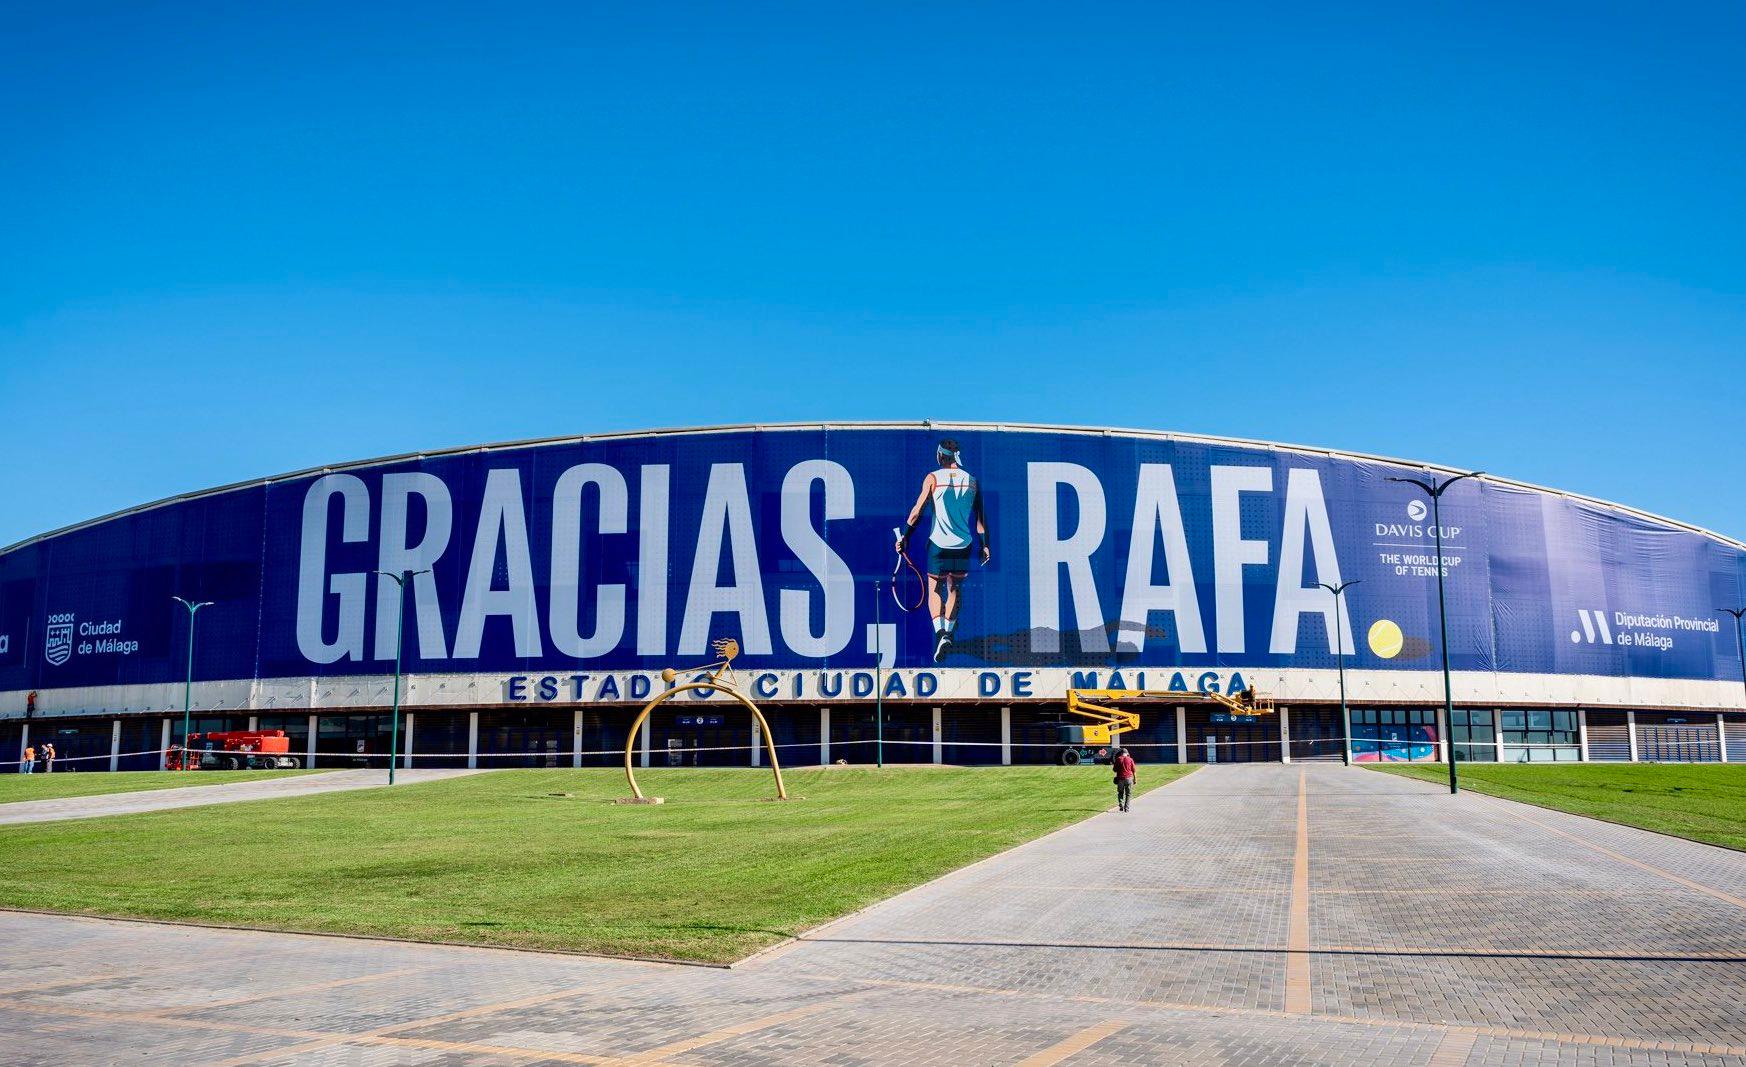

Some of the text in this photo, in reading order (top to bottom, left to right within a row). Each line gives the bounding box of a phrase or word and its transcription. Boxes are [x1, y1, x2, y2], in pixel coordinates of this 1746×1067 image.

[1375, 523, 1460, 539] DAVIS CUP
[297, 459, 1356, 668] GRACIAS, RAFA
[1380, 553, 1462, 566] THE WORLD CUP
[1395, 565, 1448, 577] OF TENNS
[79, 619, 122, 636] Ciudad
[1615, 611, 1719, 633] Diputación Provincial
[77, 639, 139, 655] de Málaga
[1617, 631, 1673, 651] de Málaga
[757, 672, 938, 698] CIUDAD
[979, 671, 1034, 698] DE
